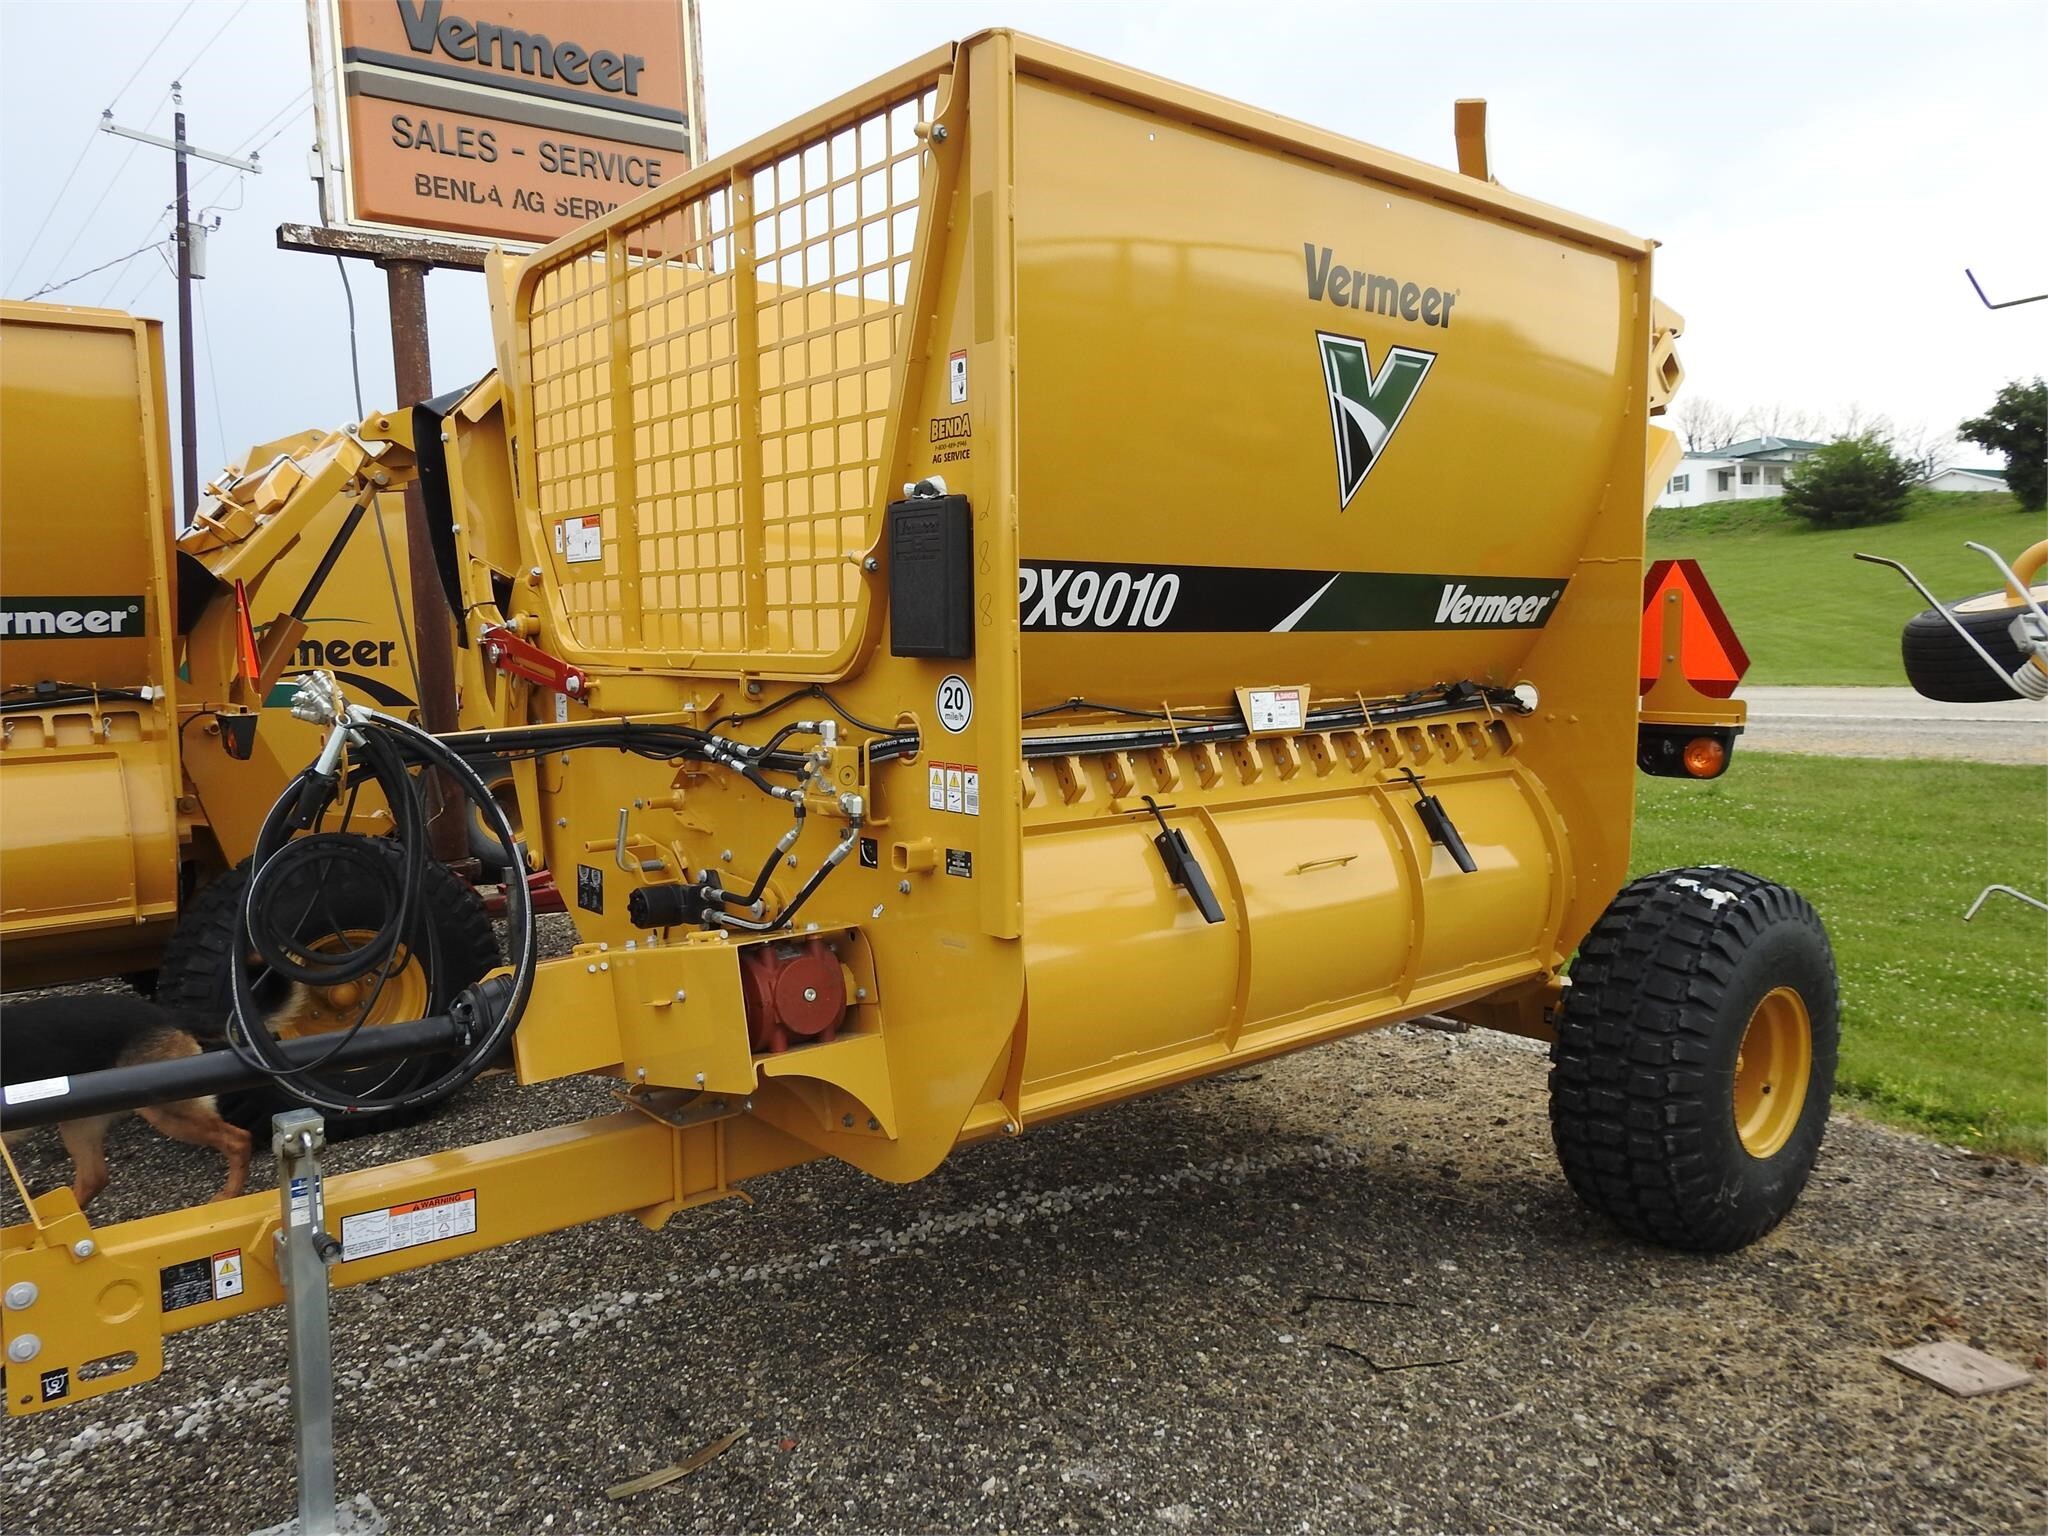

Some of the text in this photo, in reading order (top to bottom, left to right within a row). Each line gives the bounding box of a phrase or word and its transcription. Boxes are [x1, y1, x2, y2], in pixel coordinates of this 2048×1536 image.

[397, 0, 645, 96] Vermeer
[391, 115, 498, 163] SALES
[539, 141, 662, 188] SERVICE
[512, 188, 545, 214] AG
[554, 197, 619, 220] SERV
[1304, 242, 1456, 328] Vermeer
[930, 413, 971, 443] BENDA
[932, 449, 970, 464] AG SERVICE
[1019, 567, 1181, 628] PX9010
[1434, 584, 1551, 624] Vermeer
[0, 610, 128, 635] rmeer
[287, 639, 395, 667] meer
[943, 686, 964, 711] 20
[420, 1194, 461, 1209] WARNING
